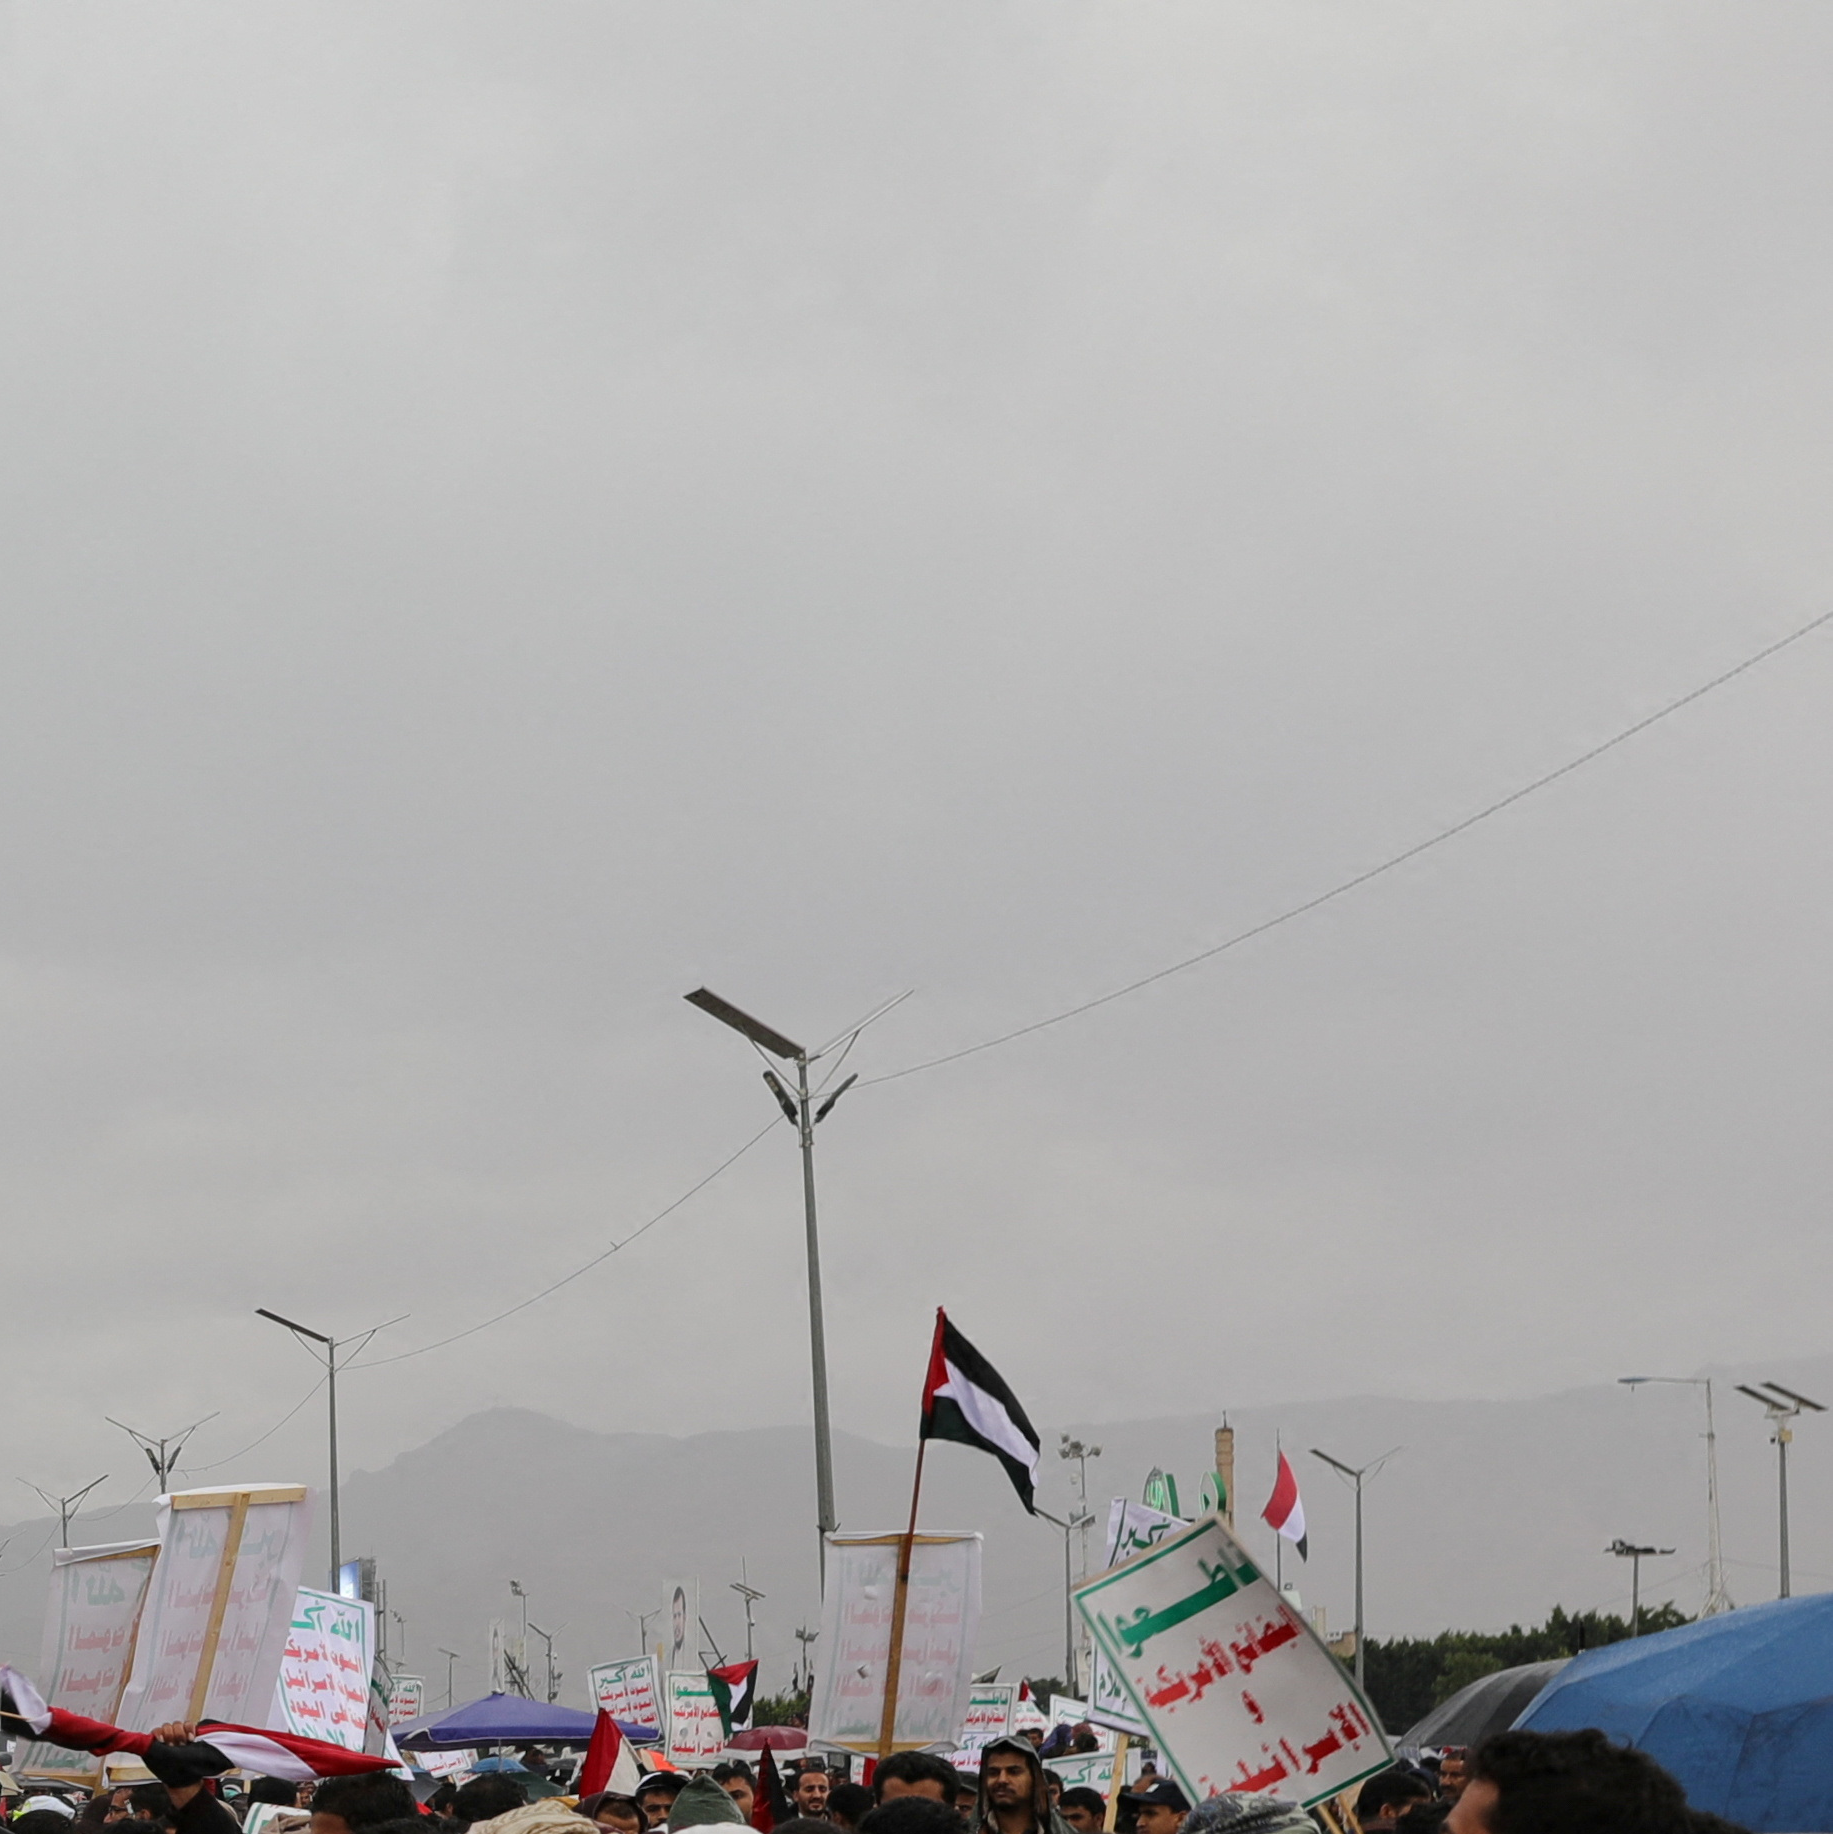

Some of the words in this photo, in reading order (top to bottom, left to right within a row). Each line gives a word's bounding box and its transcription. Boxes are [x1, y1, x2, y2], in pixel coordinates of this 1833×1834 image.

[330, 1610, 360, 1644] الله
[1230, 1603, 1302, 1675] البضائع
[330, 1651, 363, 1676] الموت
[631, 1664, 650, 1680] الله
[1135, 1636, 1235, 1714] الأمريكية
[599, 1665, 627, 1689] أكبر
[630, 1684, 652, 1696] الموت
[634, 1698, 654, 1711] الموت
[1240, 1689, 1265, 1724] و
